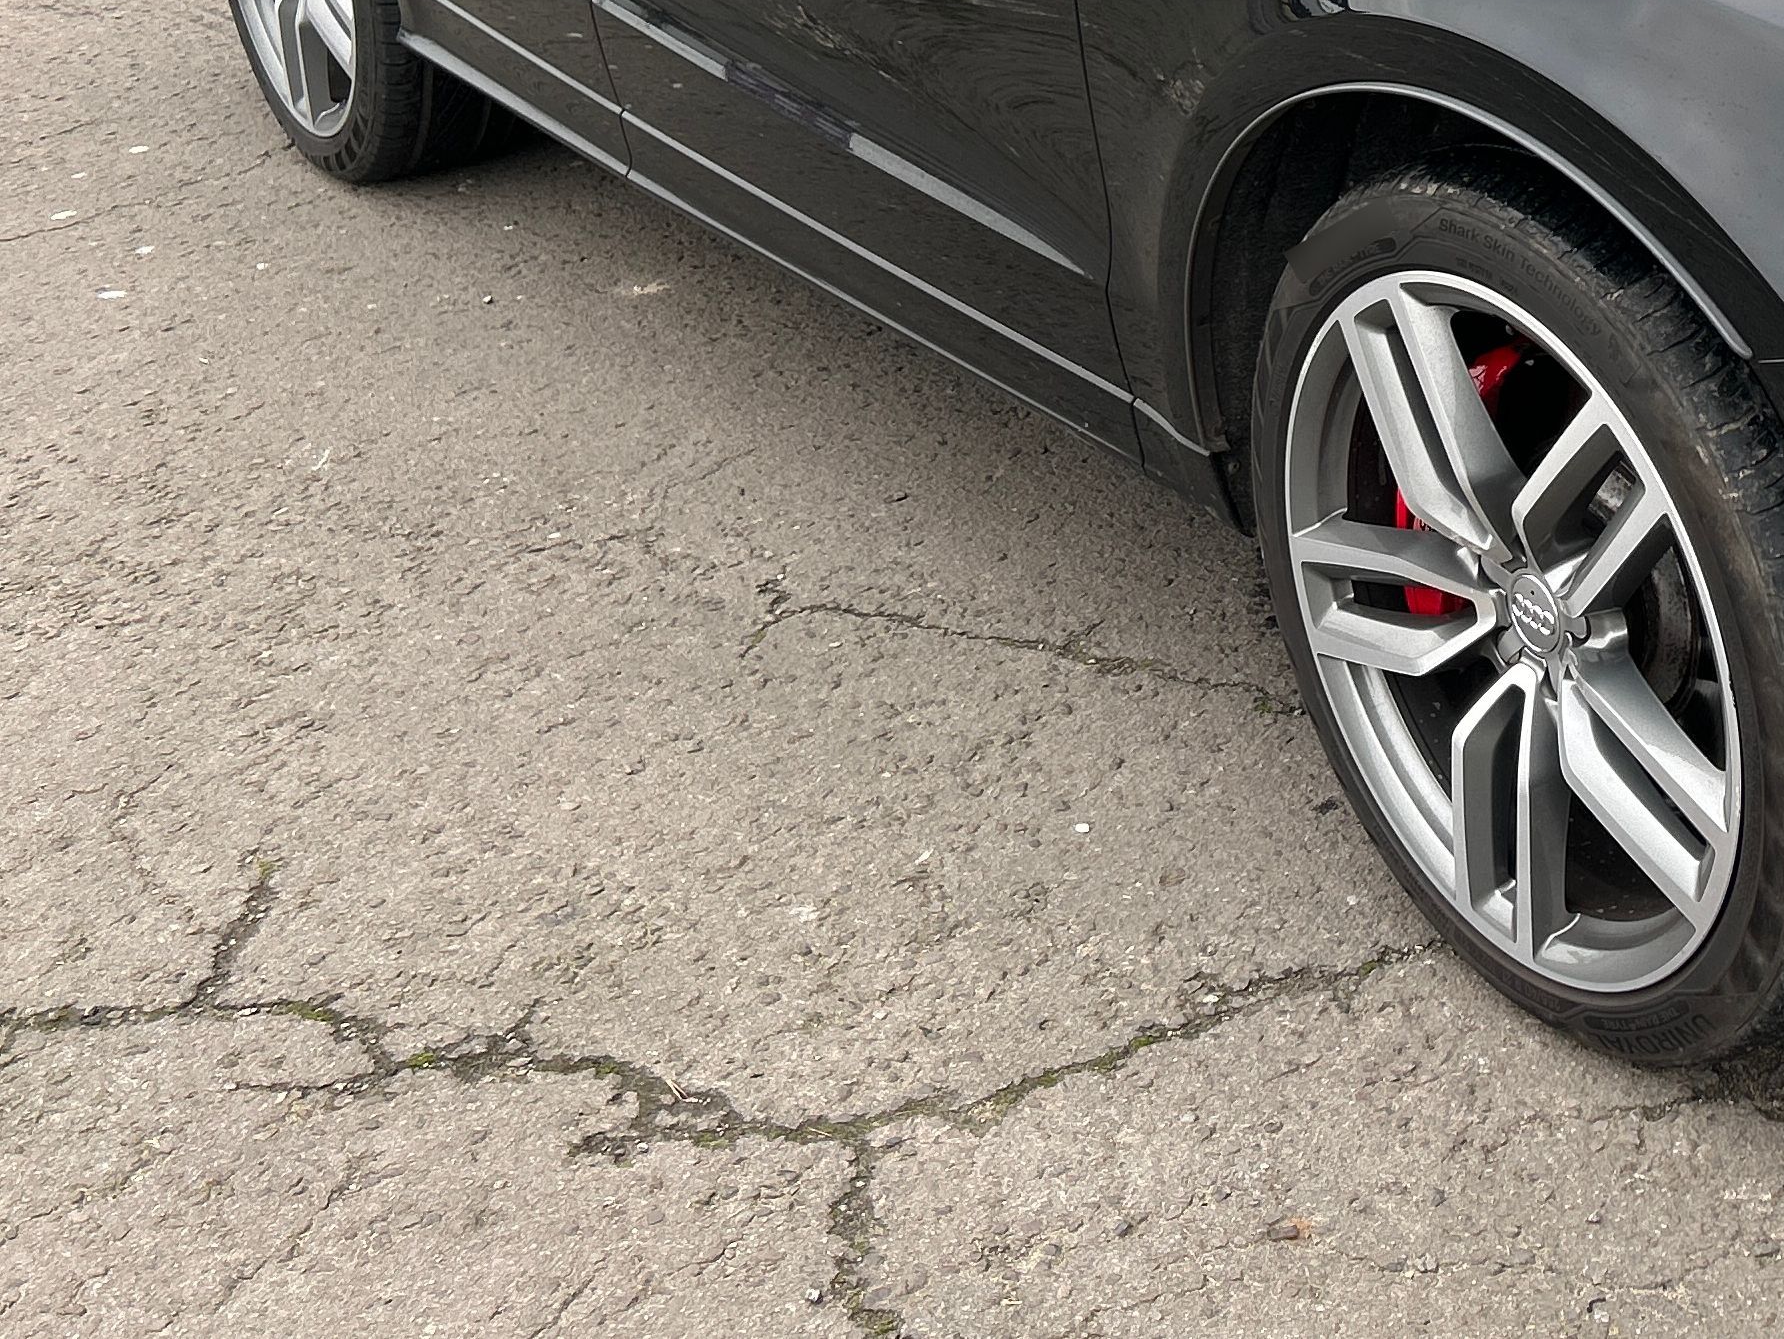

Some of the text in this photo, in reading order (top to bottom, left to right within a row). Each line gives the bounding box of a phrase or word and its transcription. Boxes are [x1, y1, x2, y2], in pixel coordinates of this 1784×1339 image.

[1438, 216, 1482, 245] Shark
[1482, 234, 1517, 264] Skin
[1517, 251, 1603, 337] Technology
[1585, 1013, 1717, 1057] UNIROYAL
